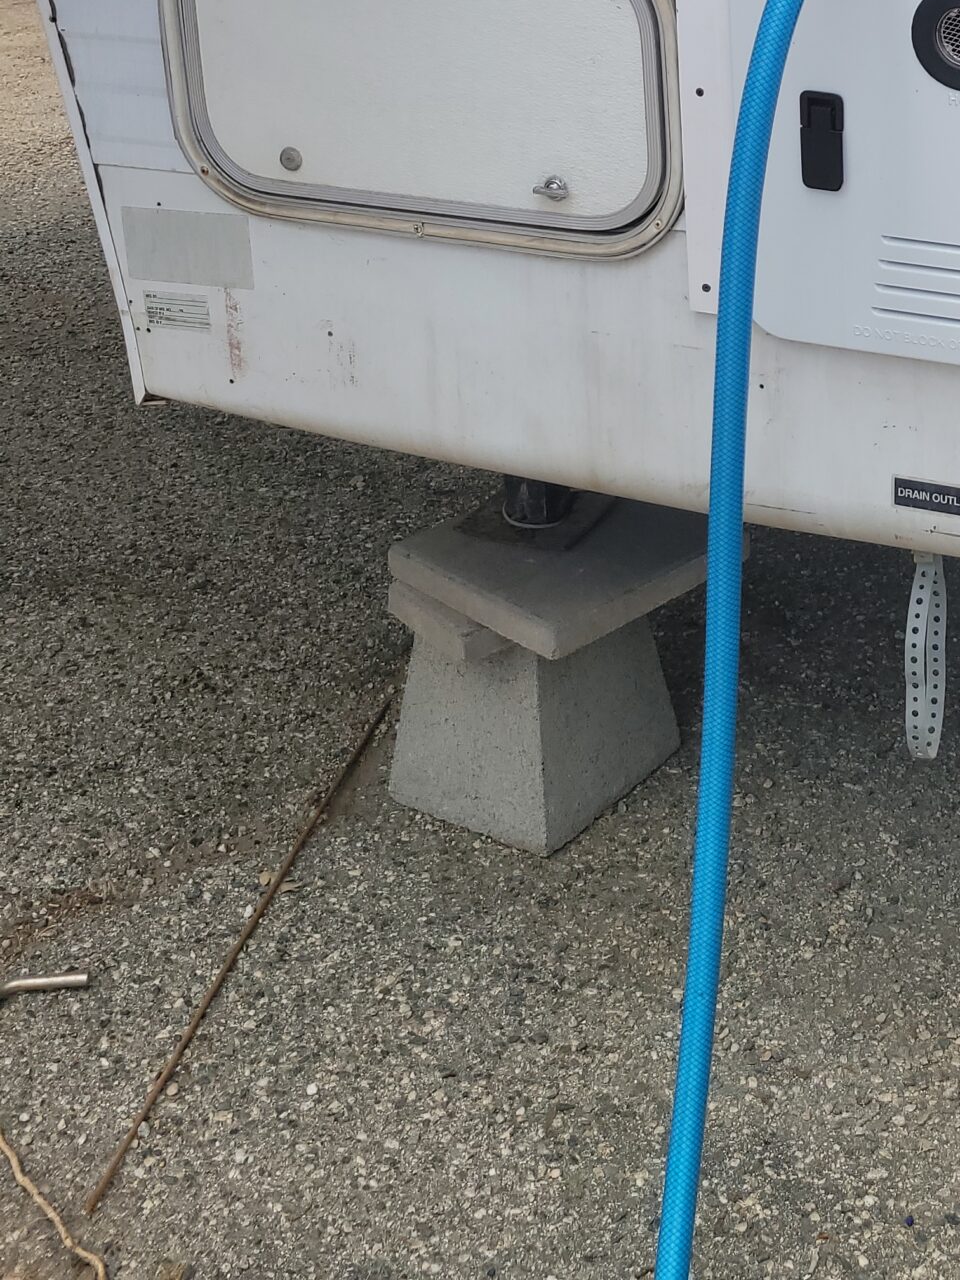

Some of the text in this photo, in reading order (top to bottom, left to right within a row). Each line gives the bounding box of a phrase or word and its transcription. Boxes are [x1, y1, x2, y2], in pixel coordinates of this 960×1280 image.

[853, 325, 872, 338] DO
[874, 327, 901, 341] NOT
[903, 331, 946, 347] BLOCK
[897, 487, 930, 502] DRAIN
